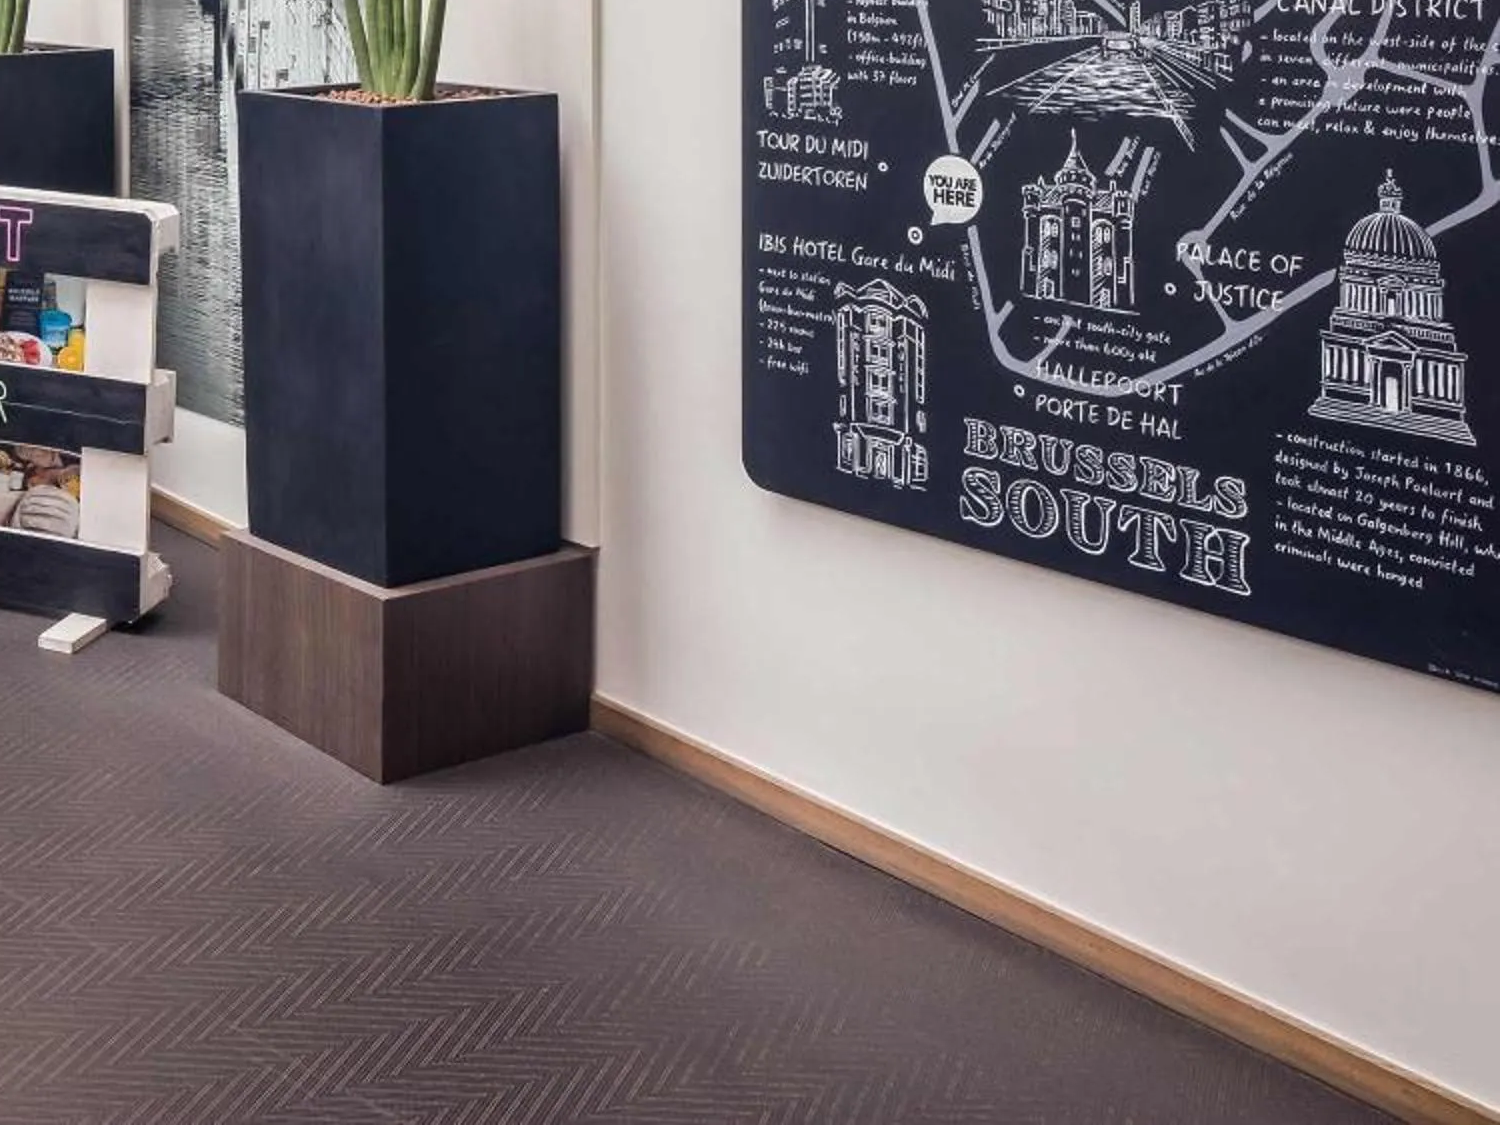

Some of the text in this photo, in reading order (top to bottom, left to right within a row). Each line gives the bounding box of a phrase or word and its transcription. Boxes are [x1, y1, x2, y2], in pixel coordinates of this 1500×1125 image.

[1259, 48, 1272, 63] in
[1278, 53, 1313, 66] seven
[1273, 27, 1316, 43] located
[1342, 31, 1363, 47] the
[1441, 35, 1457, 54] of
[1272, 76, 1288, 87] an
[1291, 77, 1321, 89] area
[1385, 105, 1421, 116] were
[1426, 104, 1472, 120] people
[756, 129, 869, 160] TOUR DU MIDI
[1257, 117, 1279, 128] can
[1325, 121, 1359, 135] relax
[1363, 121, 1376, 136] &
[1381, 125, 1419, 142] enjoy
[1425, 125, 1500, 145] themselve
[757, 161, 869, 192] ZUIDERTOREN
[928, 174, 978, 192] YOU ARE
[933, 188, 976, 208] HERE
[758, 232, 955, 281] IBIS HOTEL Gare du Midi
[1176, 242, 1304, 279] PALACE OF
[1193, 280, 1285, 313] JUSTICE
[1043, 336, 1072, 349] more
[1075, 337, 1099, 354] than
[1137, 348, 1156, 363] old
[1145, 330, 1171, 346] gate
[1036, 359, 1184, 406] HALLEPOORT
[1035, 393, 1183, 441] PORTE DE HAL
[963, 416, 1248, 520] BRUSSELS
[1287, 432, 1490, 487] construction started in 1866,
[1275, 448, 1496, 510] designed by Joseph Poelaert and
[1275, 471, 1483, 532] took almost 20 years to finish
[959, 466, 1252, 597] SOUTH
[1287, 495, 1333, 520] located
[1336, 512, 1353, 524] on
[1357, 512, 1434, 545] Galgenberg
[1438, 529, 1470, 555] Hill,
[1275, 514, 1476, 577] in the Middle Ages, convicted
[1275, 541, 1423, 590] criminals were hanged
